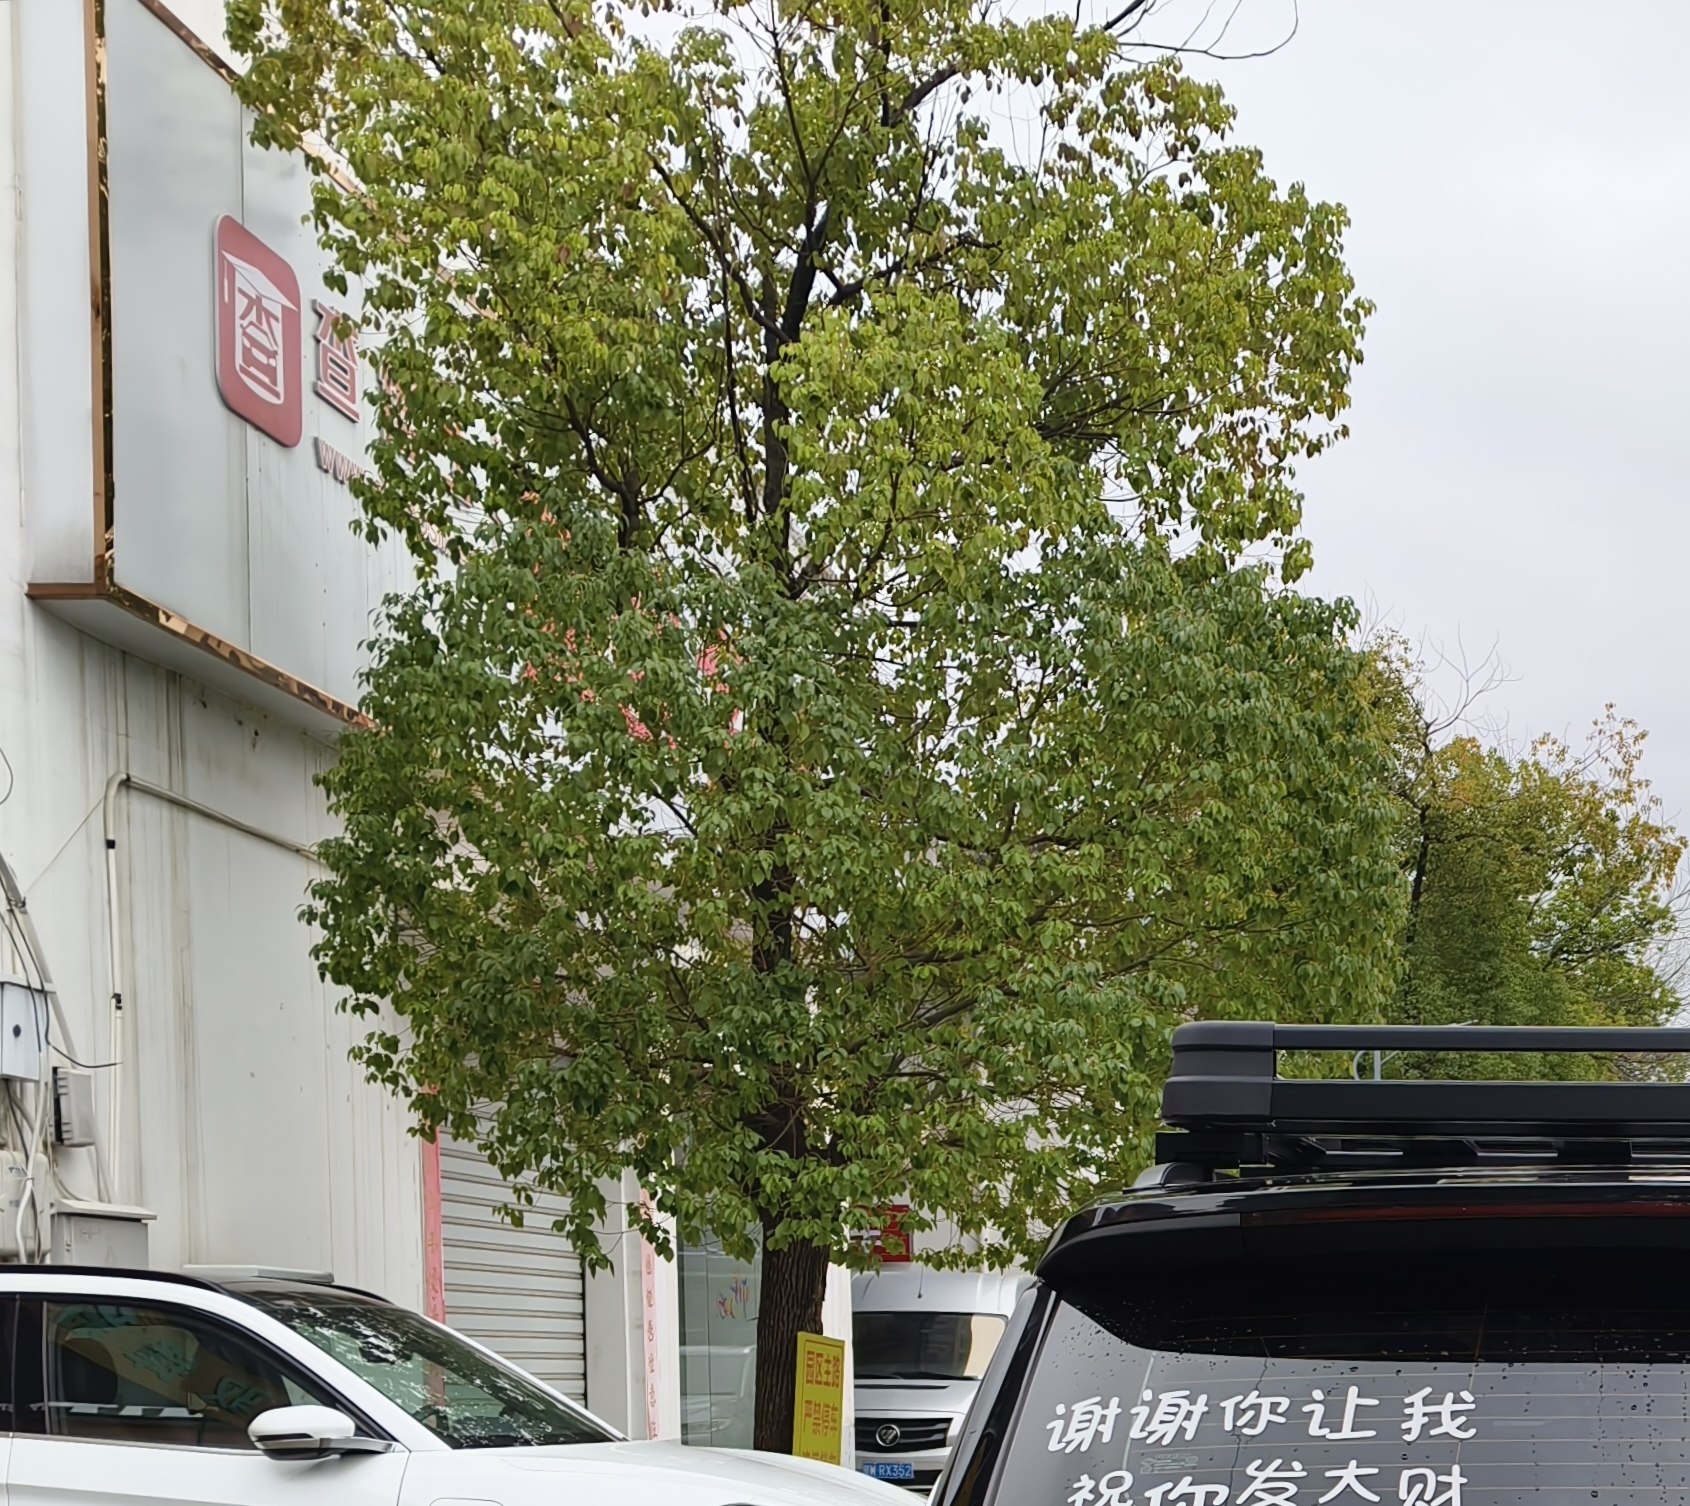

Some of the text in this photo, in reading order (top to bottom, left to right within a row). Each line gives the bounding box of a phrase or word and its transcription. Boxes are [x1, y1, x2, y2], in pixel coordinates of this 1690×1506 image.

[805, 1350, 841, 1388] 园区主路
[803, 1400, 839, 1438] 严禁停车
[1046, 1385, 1478, 1454] 谢谢你让我
